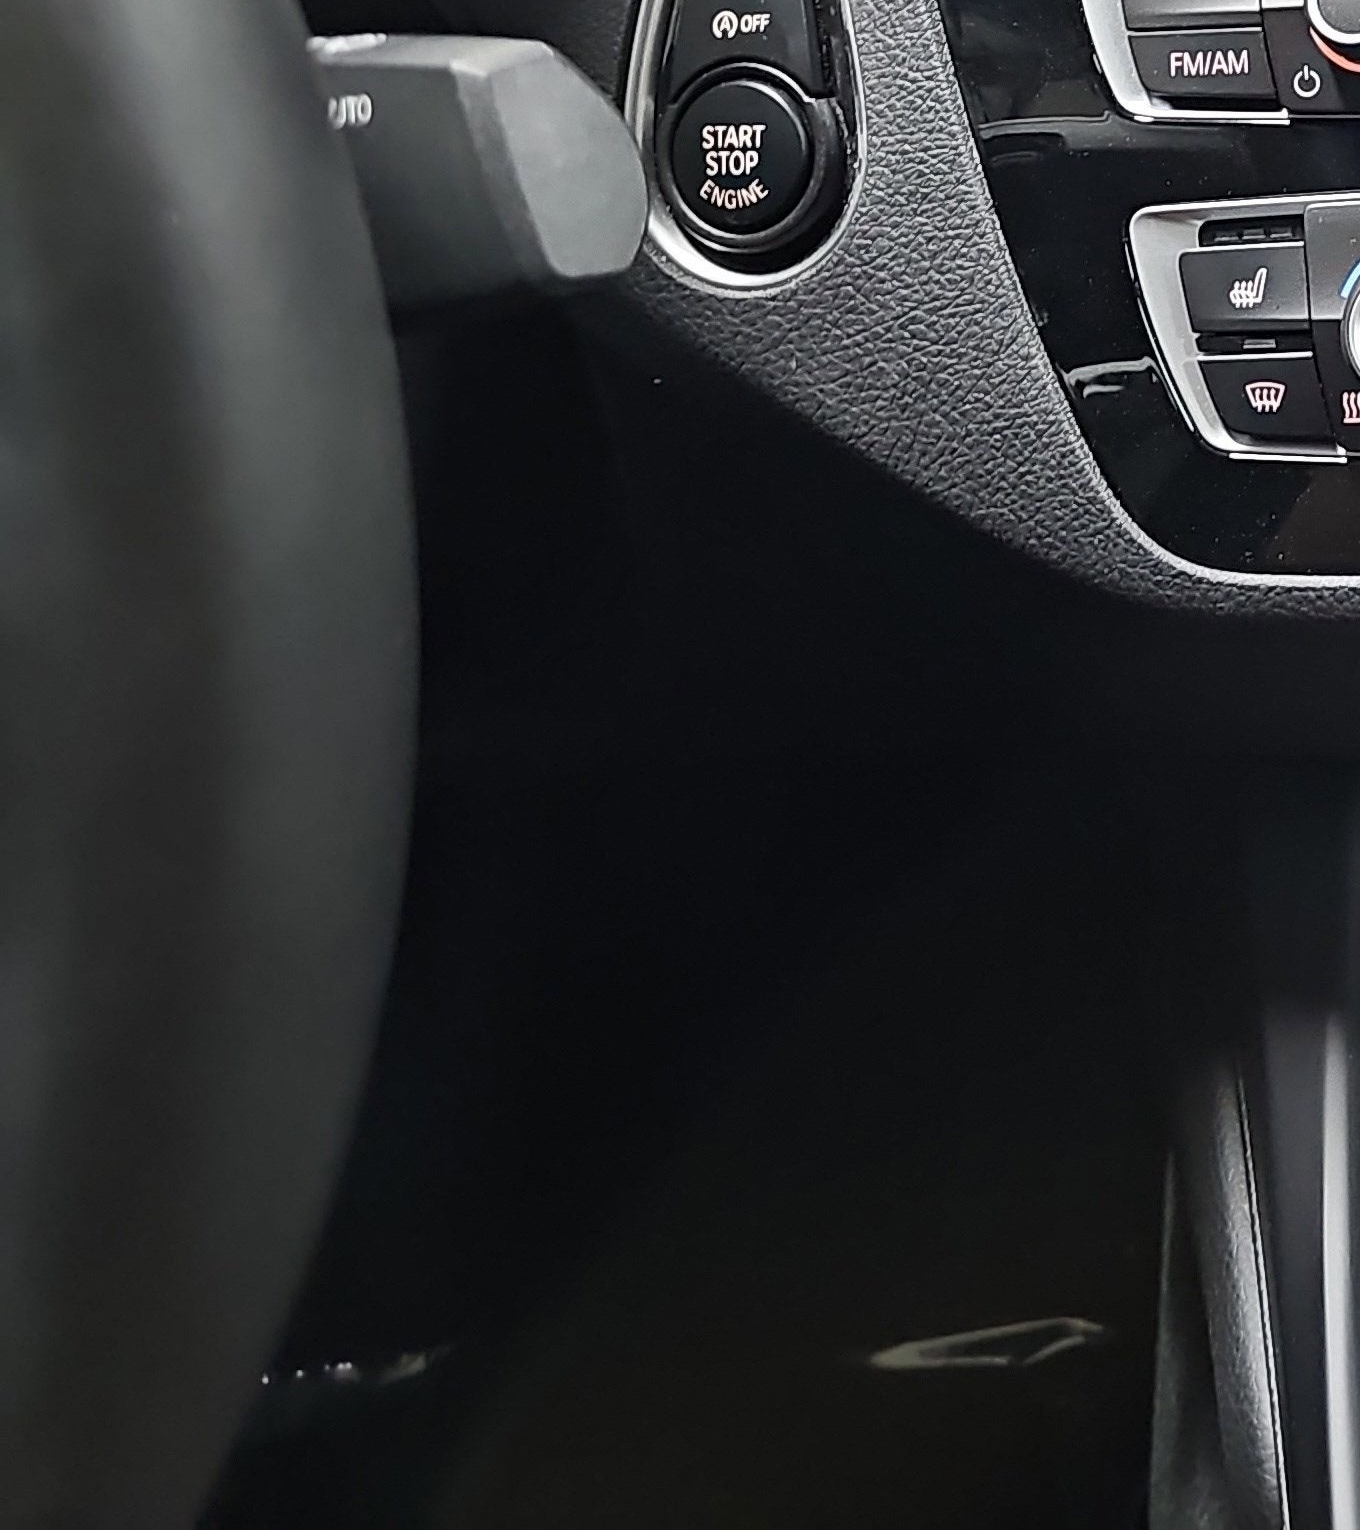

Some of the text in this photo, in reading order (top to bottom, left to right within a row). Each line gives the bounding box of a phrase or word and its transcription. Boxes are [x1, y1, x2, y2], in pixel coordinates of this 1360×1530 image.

[740, 13, 771, 33] OFF
[1170, 49, 1249, 77] FM/AM
[328, 93, 372, 130] UTO
[701, 124, 767, 150] START
[704, 149, 759, 177] STOP
[699, 178, 769, 210] ENGINE
